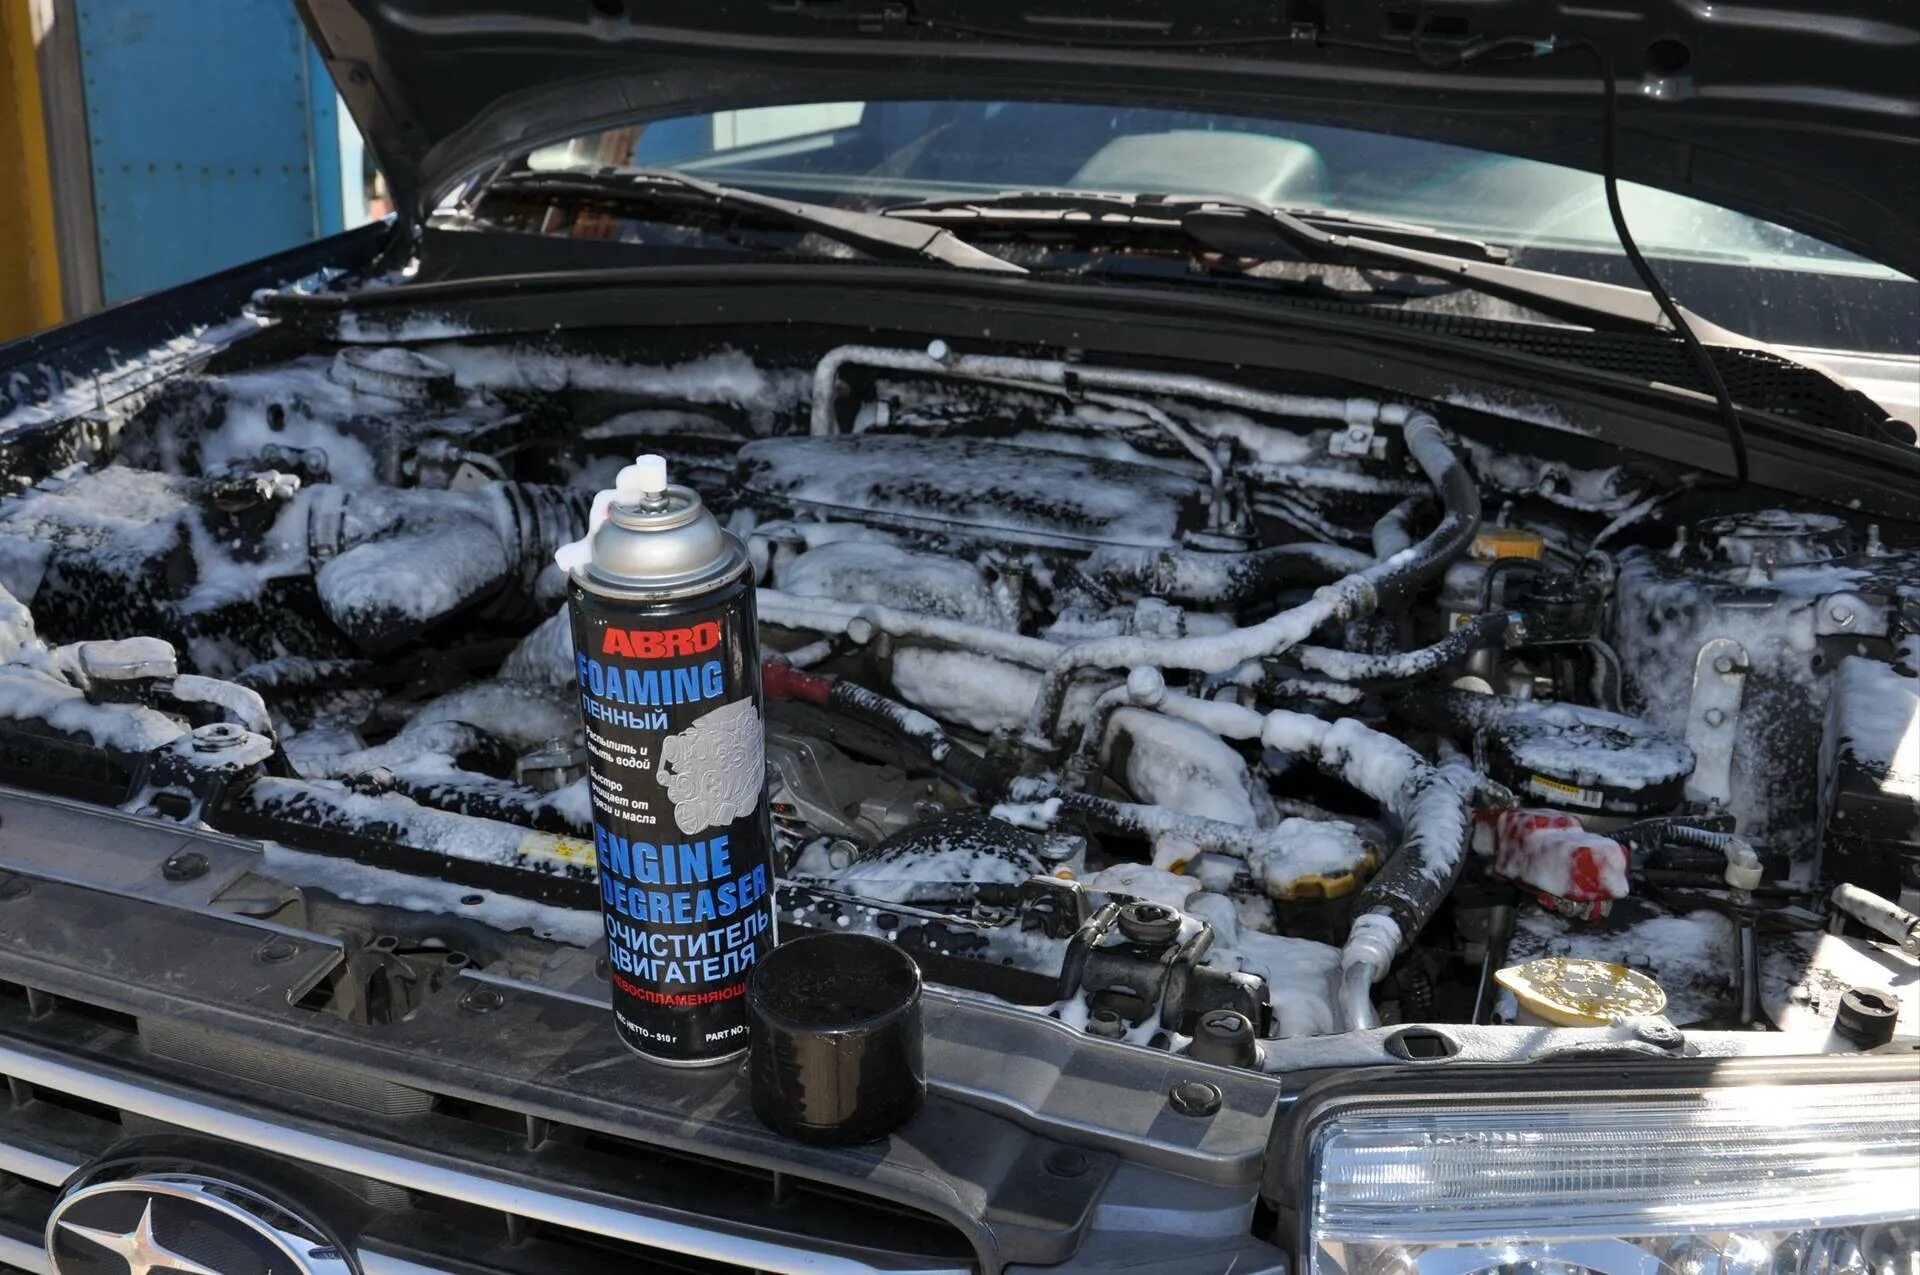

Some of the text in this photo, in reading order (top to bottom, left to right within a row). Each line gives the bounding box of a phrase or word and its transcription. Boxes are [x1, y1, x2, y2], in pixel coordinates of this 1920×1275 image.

[602, 621, 720, 659] ABRO
[577, 651, 724, 706] FOAMING
[582, 693, 669, 730] ПЕННЫЙ
[616, 756, 650, 770] водой
[640, 747, 648, 756] и
[614, 809, 620, 817] и
[622, 811, 656, 824] масла
[631, 800, 649, 810] от
[594, 822, 732, 885] ENGINE
[601, 863, 768, 924] DEGREASER
[605, 909, 769, 958] ОЧИСТИТЕЛЬ
[608, 937, 756, 984] ДВИГАТЕЛЯ
[705, 1030, 729, 1042] PART
